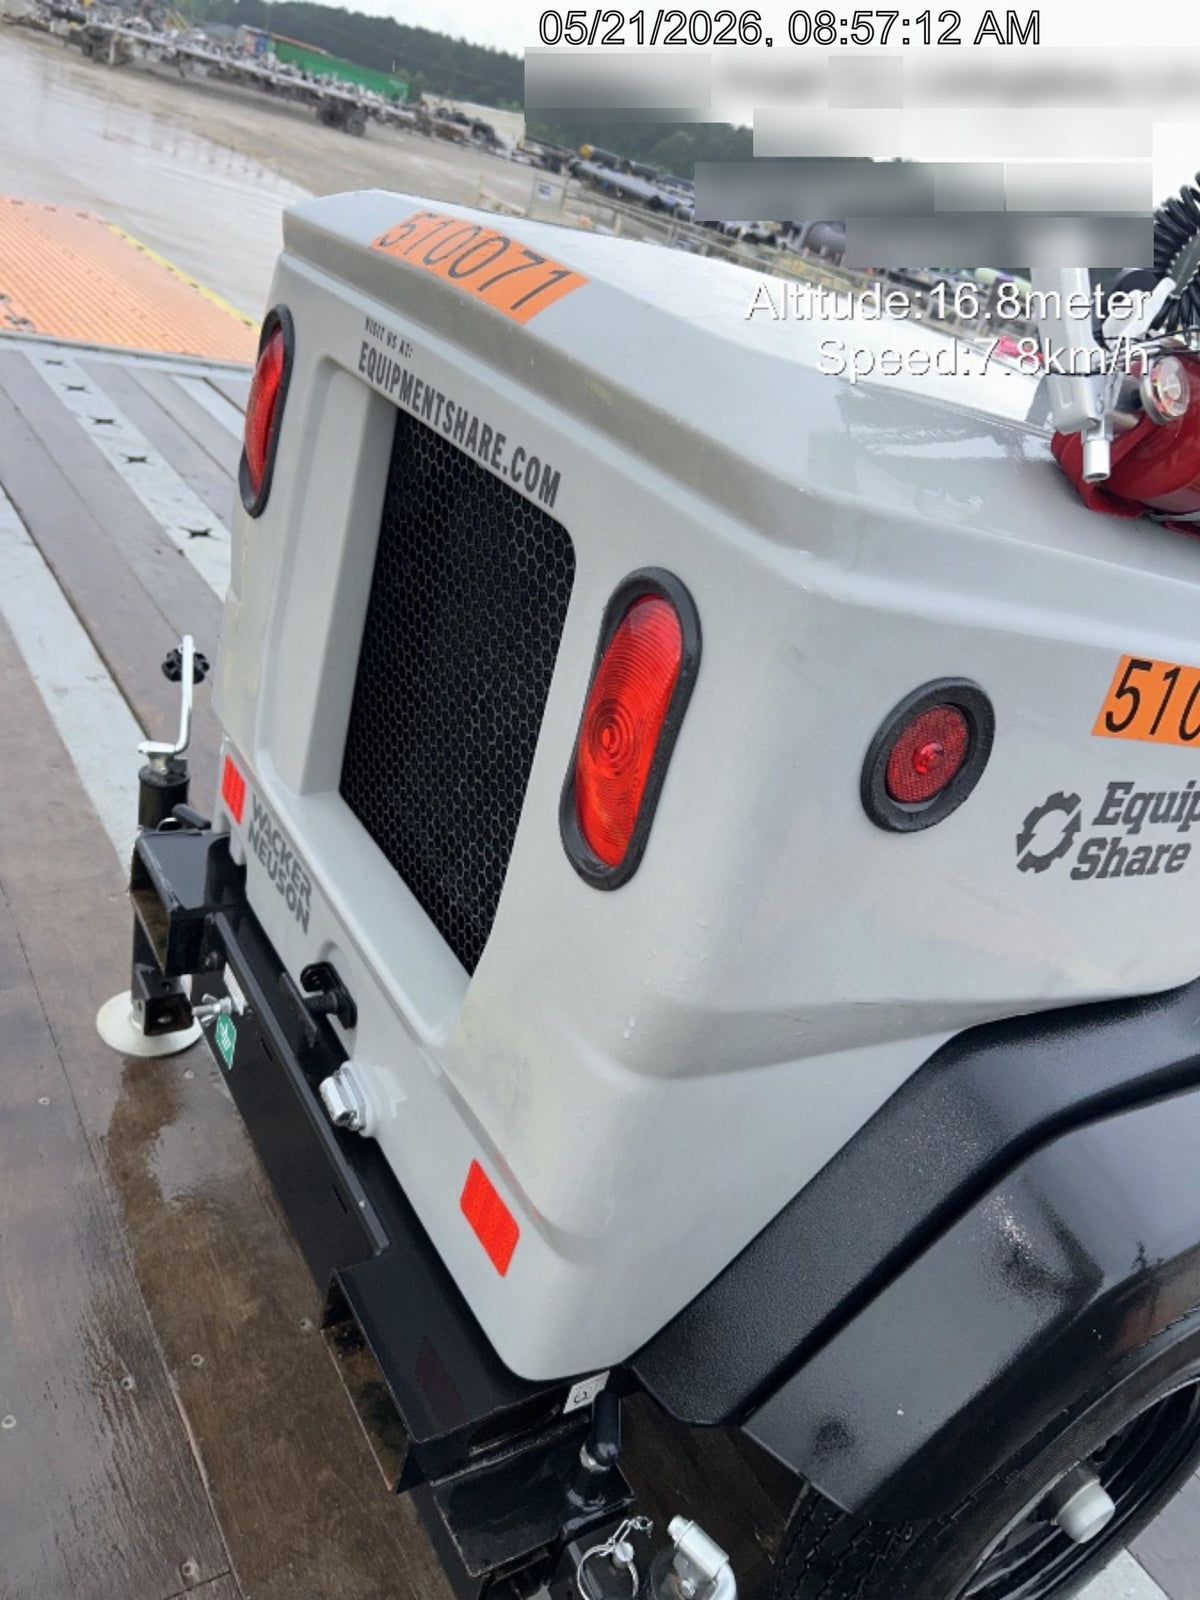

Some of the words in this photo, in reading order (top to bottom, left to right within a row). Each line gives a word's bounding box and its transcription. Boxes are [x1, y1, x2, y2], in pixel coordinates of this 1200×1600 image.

[379, 212, 571, 310] 510071
[365, 316, 385, 341] VISIT
[387, 331, 397, 350] US
[358, 341, 561, 509] EQUIPMENTSHARE.COM
[248, 818, 310, 935] NEUSON
[252, 792, 312, 909] WACKER
[1070, 837, 1191, 880] Share
